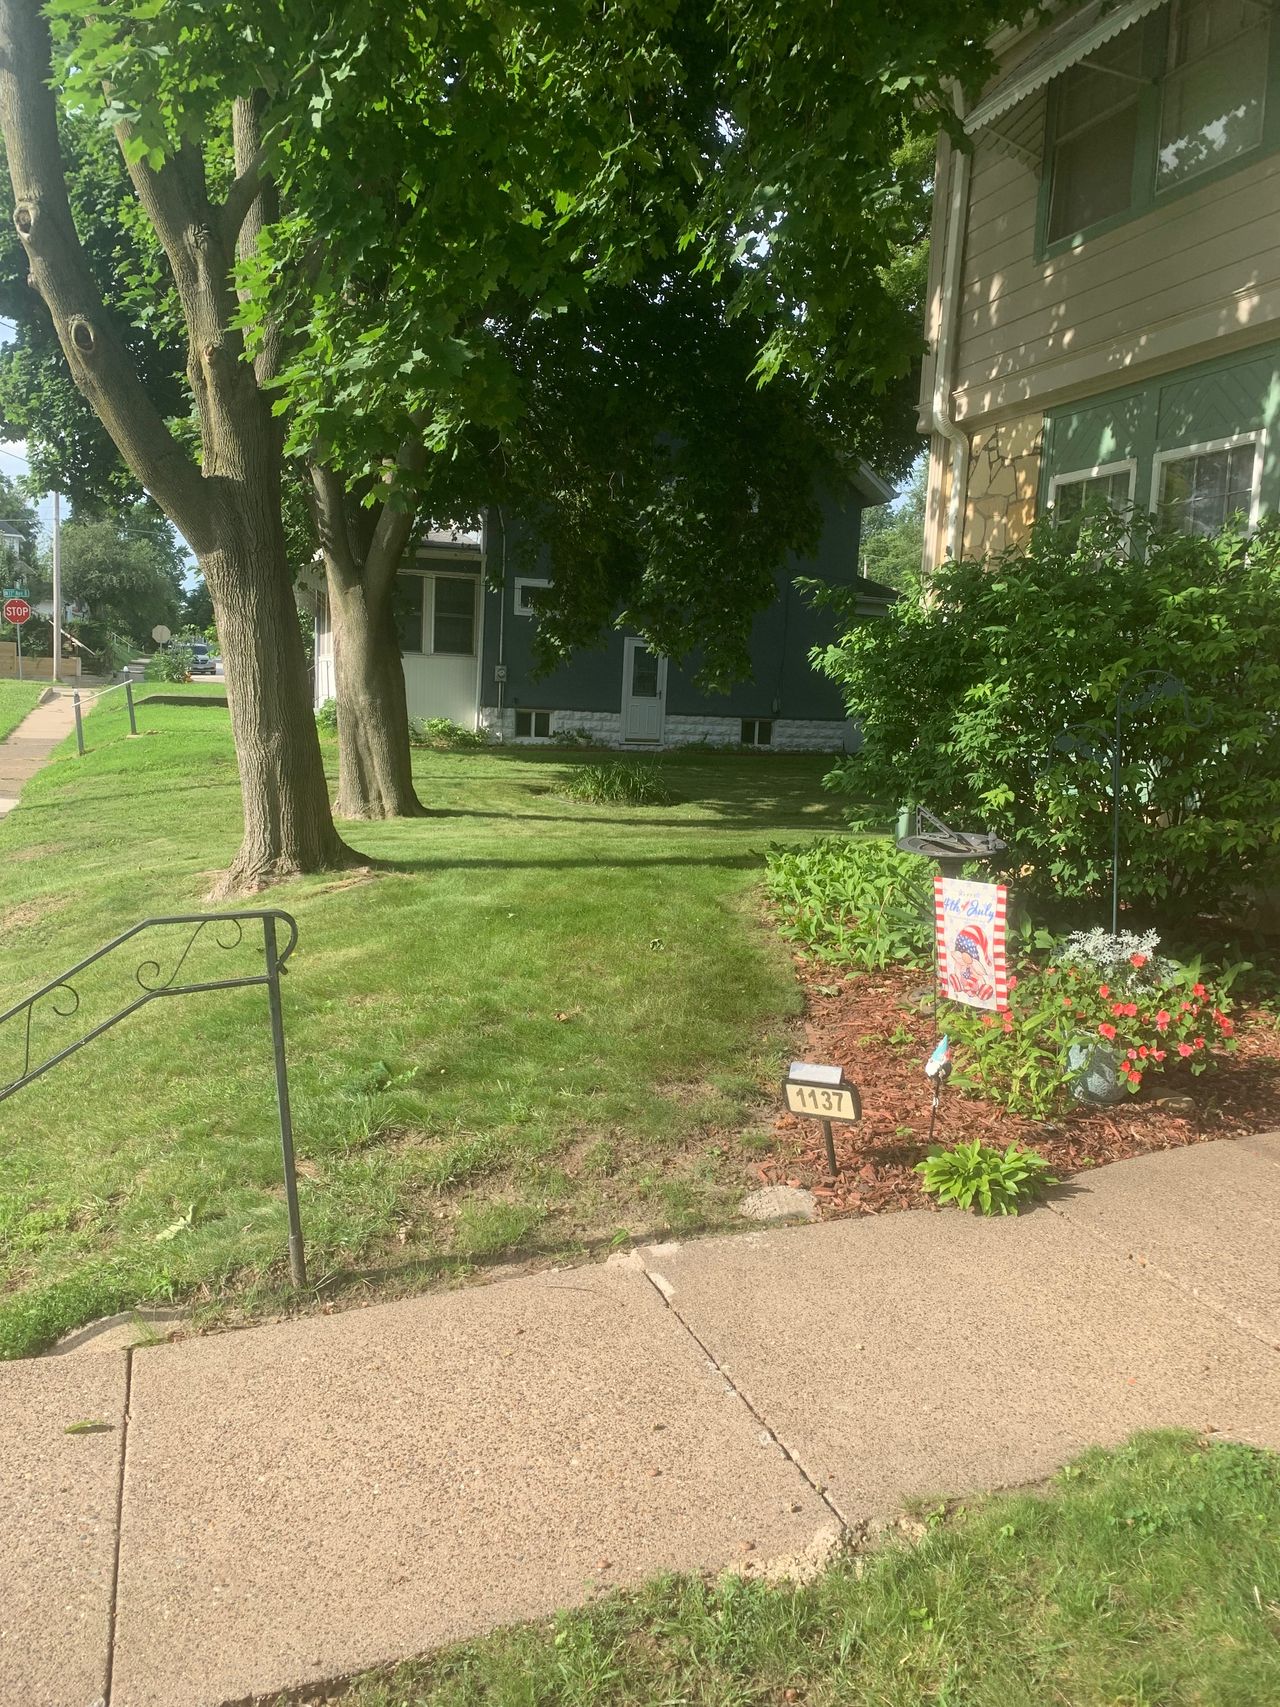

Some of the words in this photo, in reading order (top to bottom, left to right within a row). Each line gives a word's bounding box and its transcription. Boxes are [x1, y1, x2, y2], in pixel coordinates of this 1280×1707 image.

[6, 606, 29, 616] STOP
[944, 897, 960, 912] 4th
[966, 899, 994, 923] July
[796, 1087, 843, 1112] 1137
